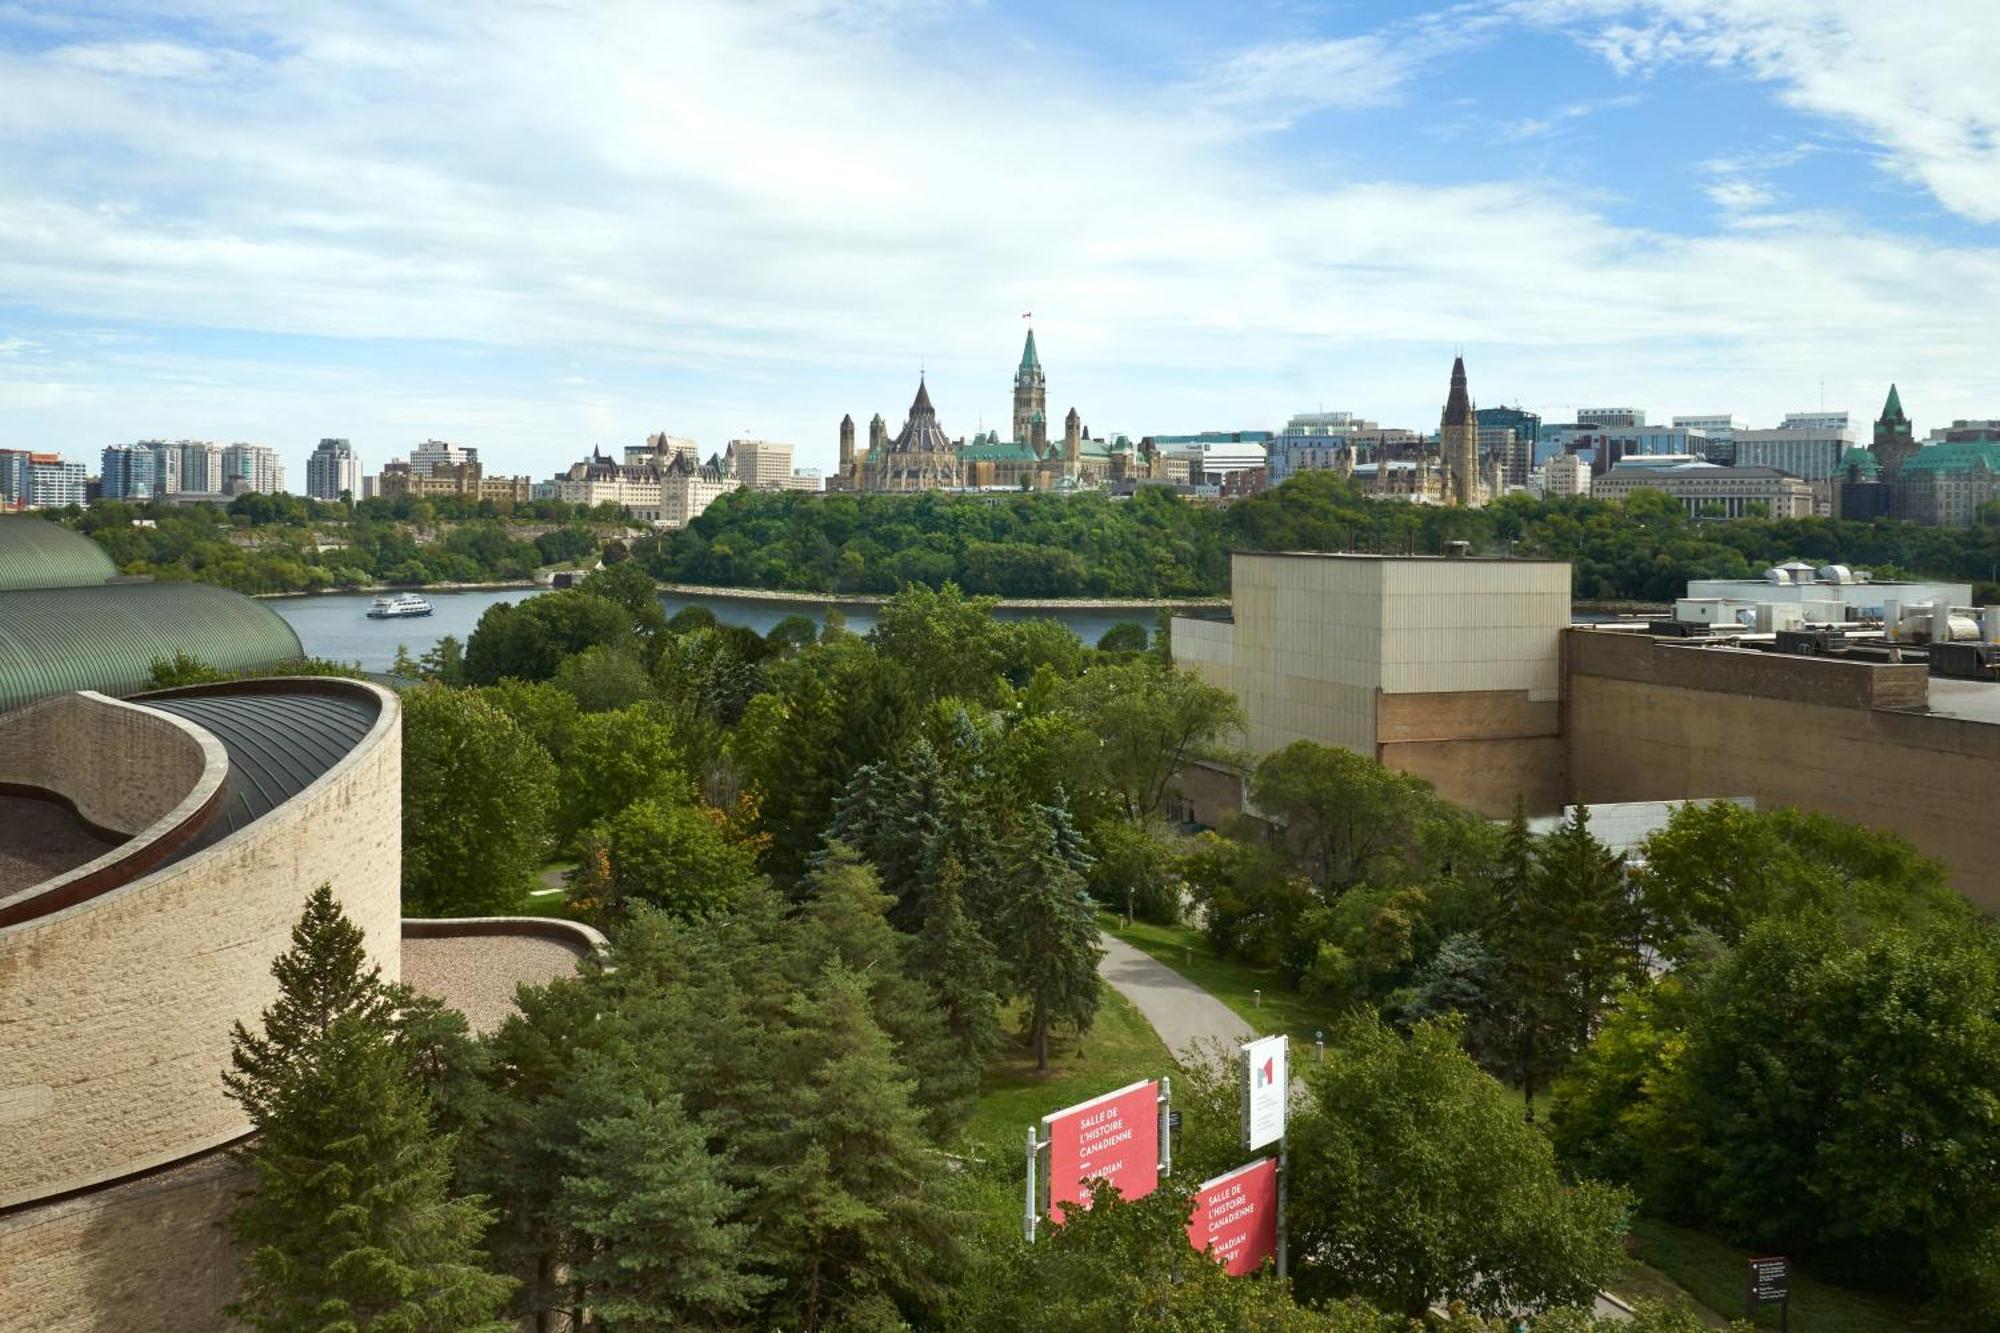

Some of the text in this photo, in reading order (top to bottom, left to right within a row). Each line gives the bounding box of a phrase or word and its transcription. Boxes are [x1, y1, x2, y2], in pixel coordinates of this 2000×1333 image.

[1081, 1107, 1118, 1130] SALLE DE
[1080, 1119, 1123, 1144] L'HISTOIRE
[1080, 1128, 1132, 1158] CANADIENNE
[1208, 1184, 1241, 1206] SALLE DE
[1208, 1194, 1246, 1219] L'HISTOIRE
[1208, 1203, 1255, 1232] CANADIENNE
[1214, 1232, 1247, 1255] ANADIAN
